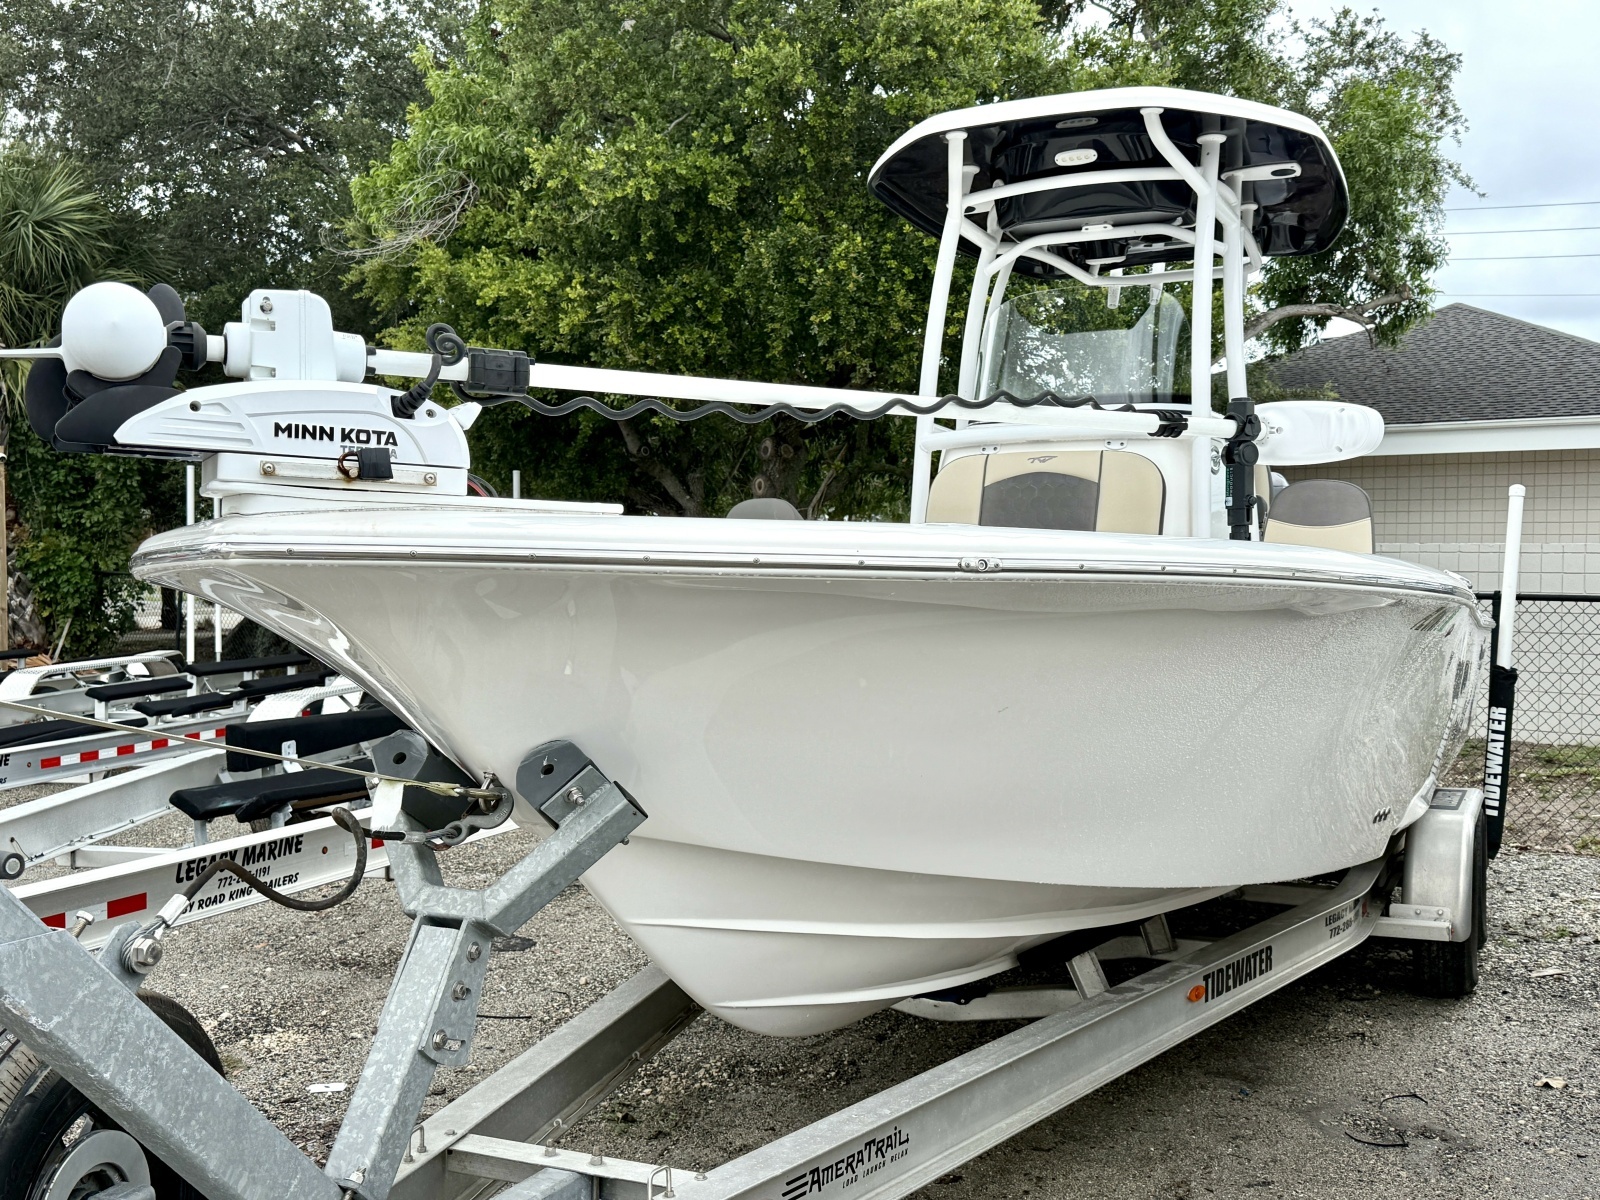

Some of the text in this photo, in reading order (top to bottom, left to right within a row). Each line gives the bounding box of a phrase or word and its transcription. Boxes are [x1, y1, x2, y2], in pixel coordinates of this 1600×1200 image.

[274, 422, 398, 446] MINN KOTA
[340, 445, 398, 459] TERA
[1484, 706, 1507, 817] TIDEWATER
[241, 834, 304, 866] MARINE
[197, 893, 226, 910] ROAD
[228, 886, 253, 901] KING
[257, 872, 299, 893] AILERS
[217, 865, 271, 889] 772-2-1191
[1203, 945, 1273, 1003] TIDEWATER
[842, 1148, 909, 1189] LOAD LAUNCH RELAX
